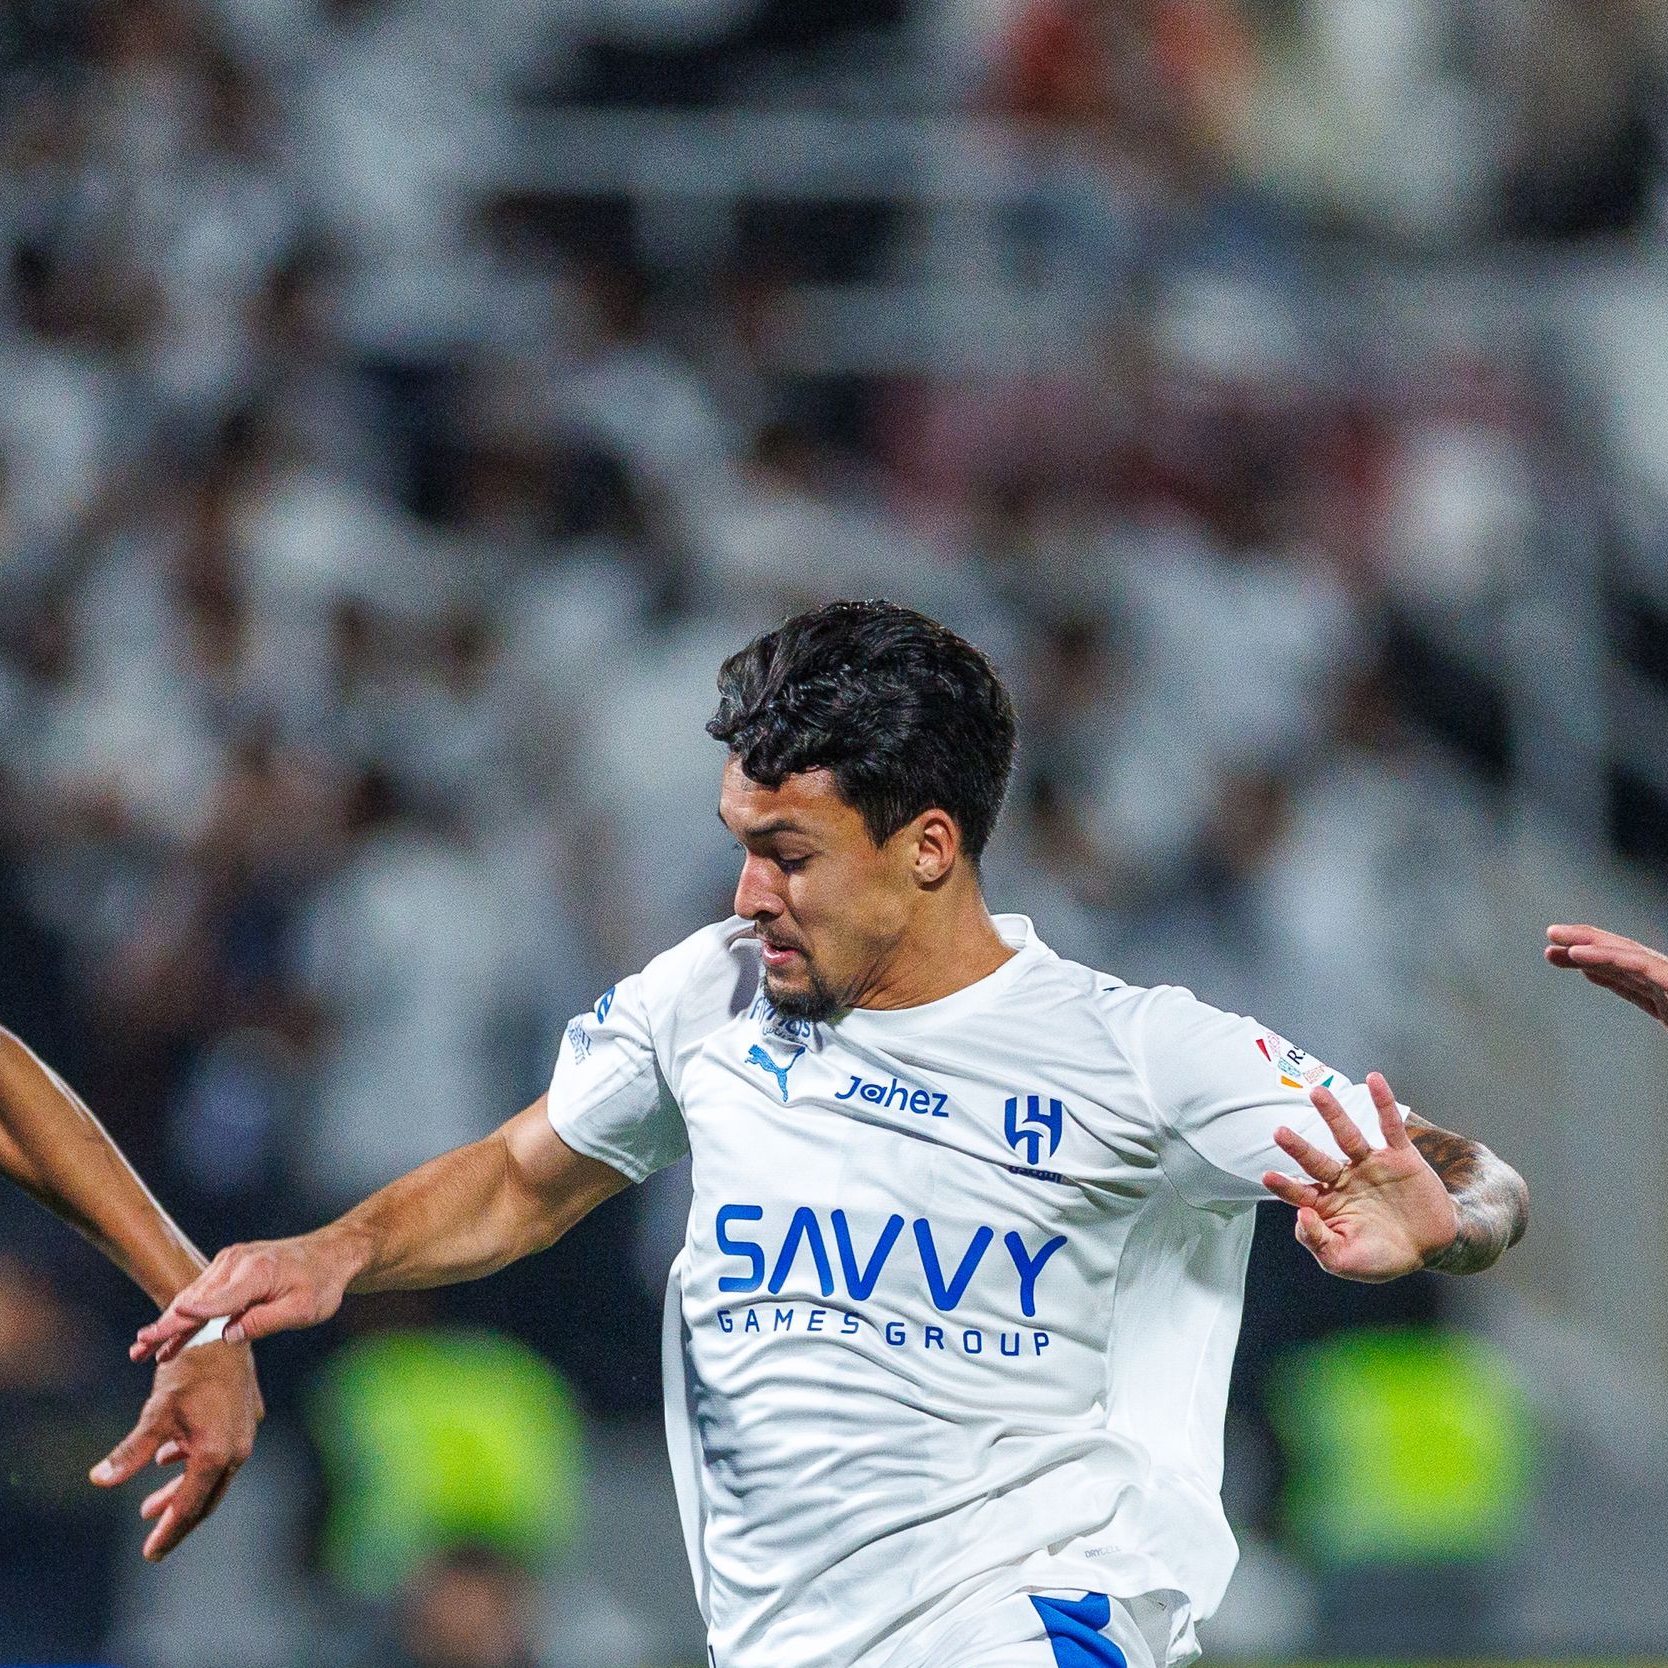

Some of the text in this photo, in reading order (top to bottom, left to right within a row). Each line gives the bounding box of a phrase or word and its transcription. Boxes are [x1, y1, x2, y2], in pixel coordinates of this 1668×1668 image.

[834, 1074, 951, 1118] Jahez
[715, 1203, 1069, 1318] SAVVY
[717, 1307, 1050, 1356] GAMES GROUP
